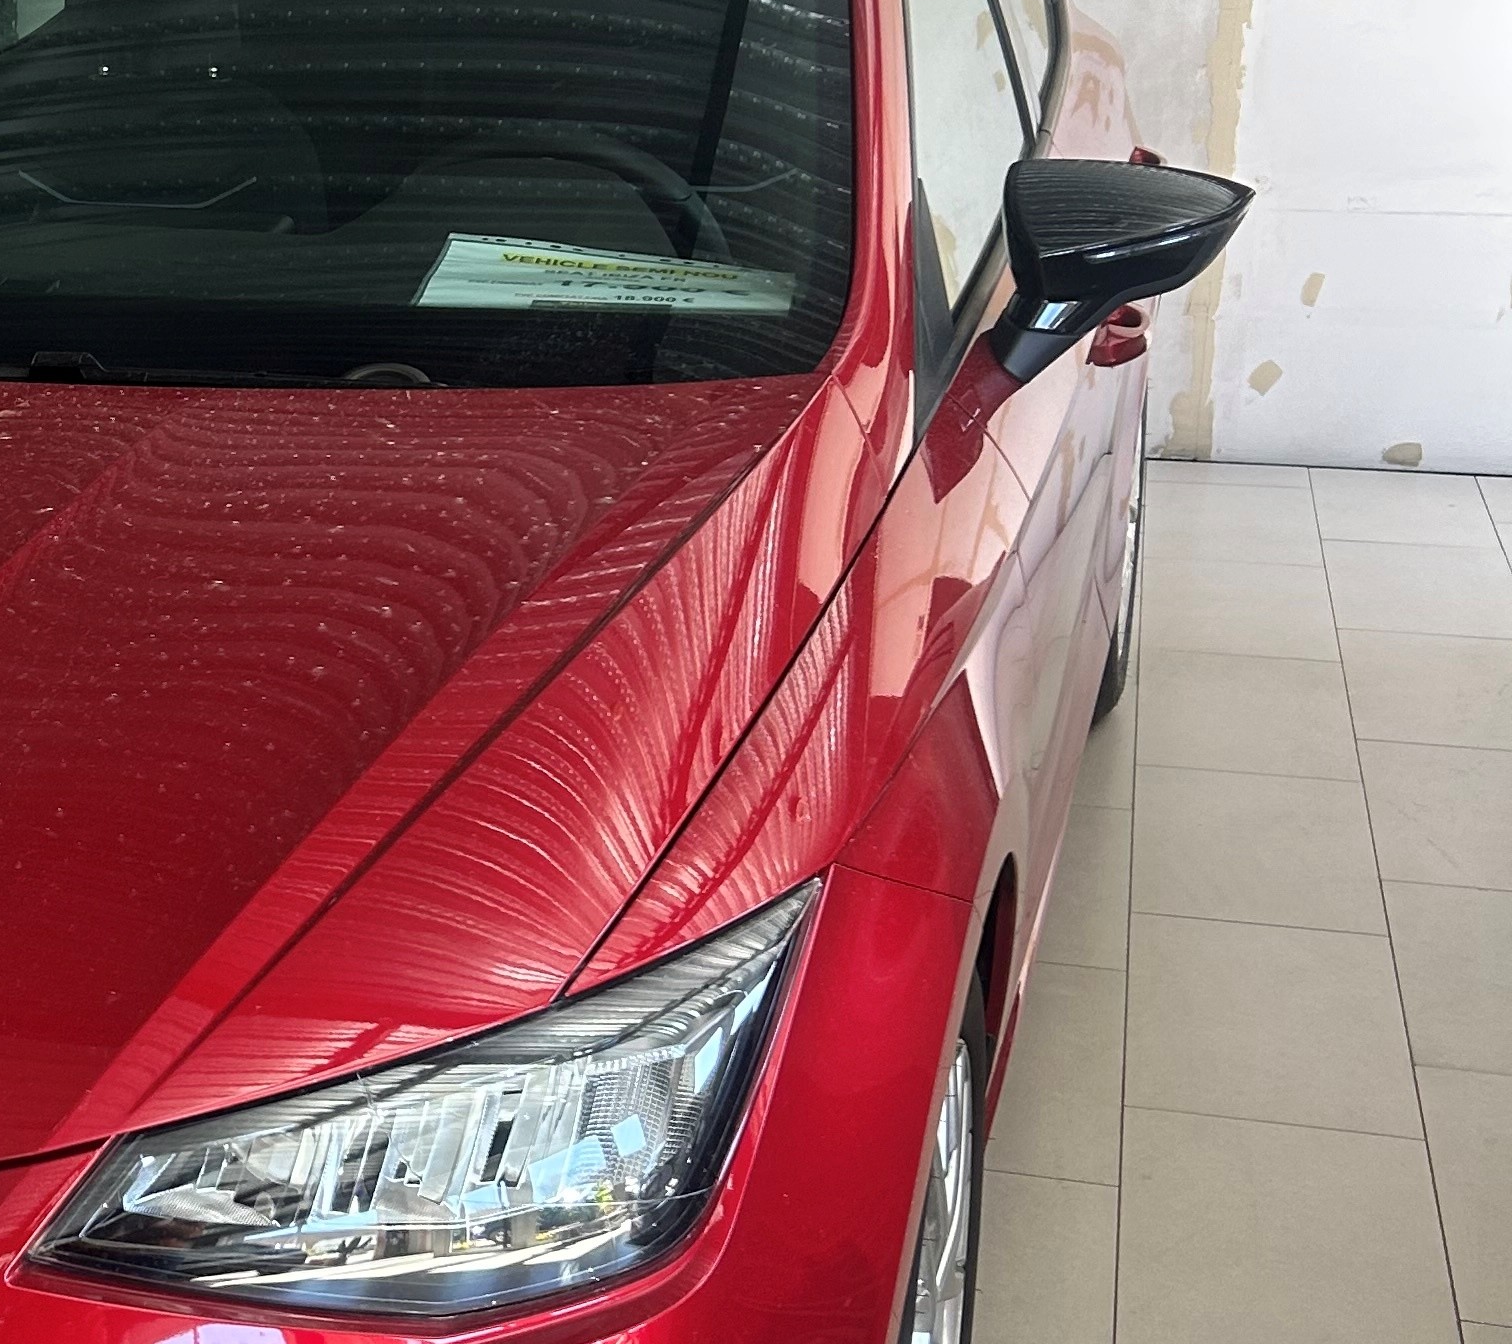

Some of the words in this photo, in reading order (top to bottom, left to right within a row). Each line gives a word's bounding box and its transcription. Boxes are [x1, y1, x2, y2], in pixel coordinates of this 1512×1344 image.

[503, 253, 608, 271] VEHICLE
[616, 265, 675, 275] SEMI
[684, 269, 738, 280] NOU
[682, 296, 696, 304] €
